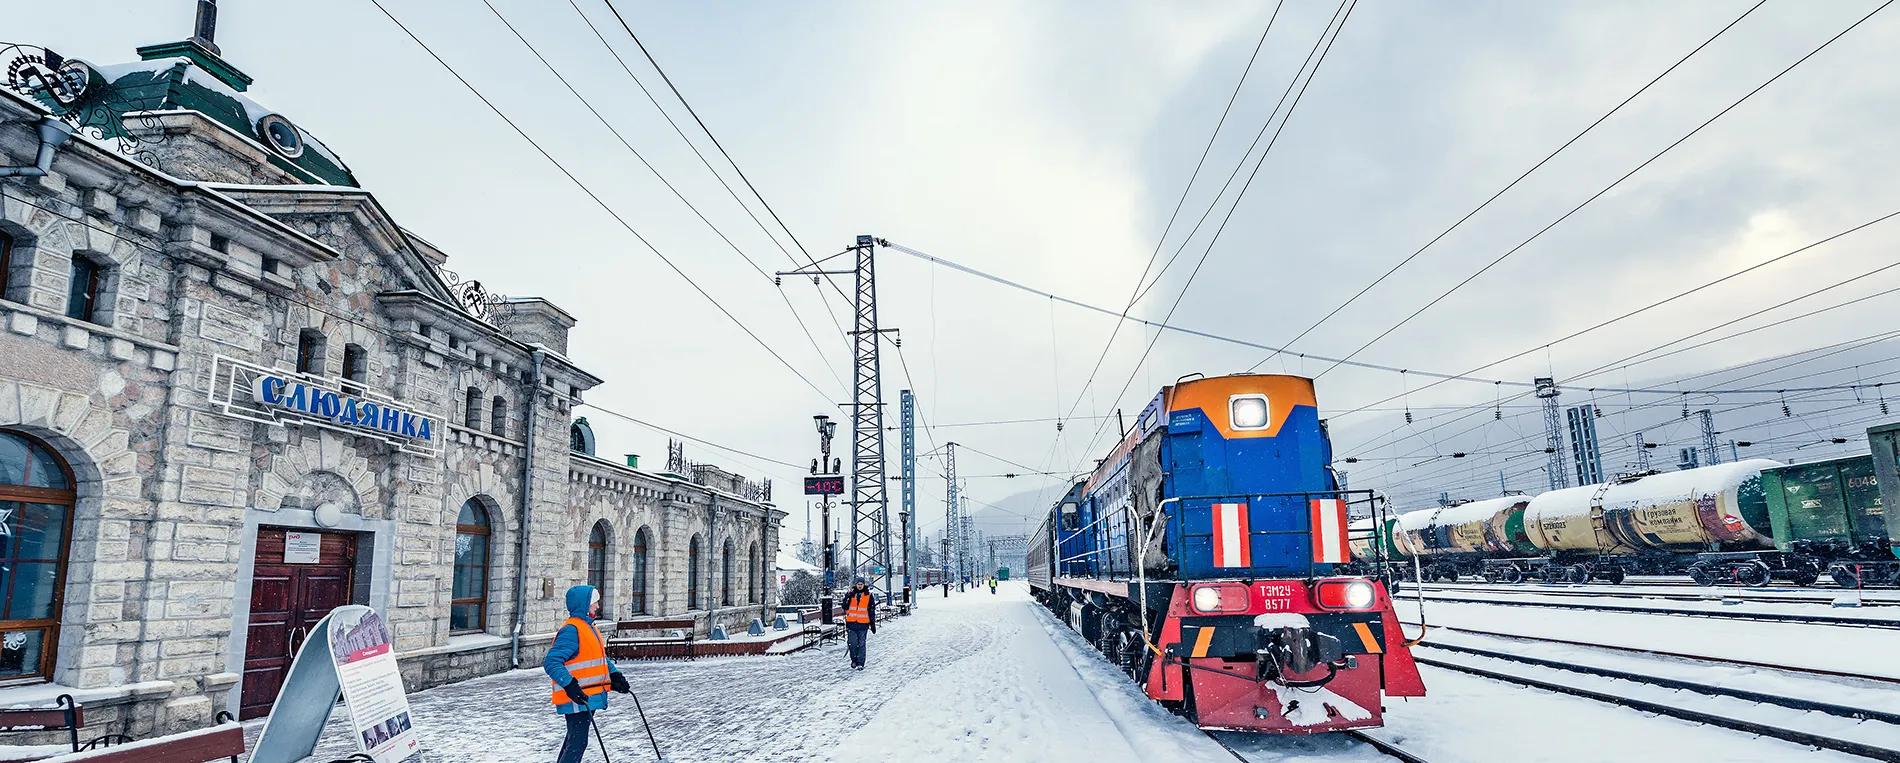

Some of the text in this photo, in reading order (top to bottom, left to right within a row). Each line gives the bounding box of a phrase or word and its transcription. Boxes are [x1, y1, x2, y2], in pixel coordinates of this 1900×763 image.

[257, 375, 432, 441] СЛЮДЯНКА
[1848, 475, 1878, 488] 6048
[1647, 508, 1677, 519] грузовая
[1265, 598, 1290, 610] 8577
